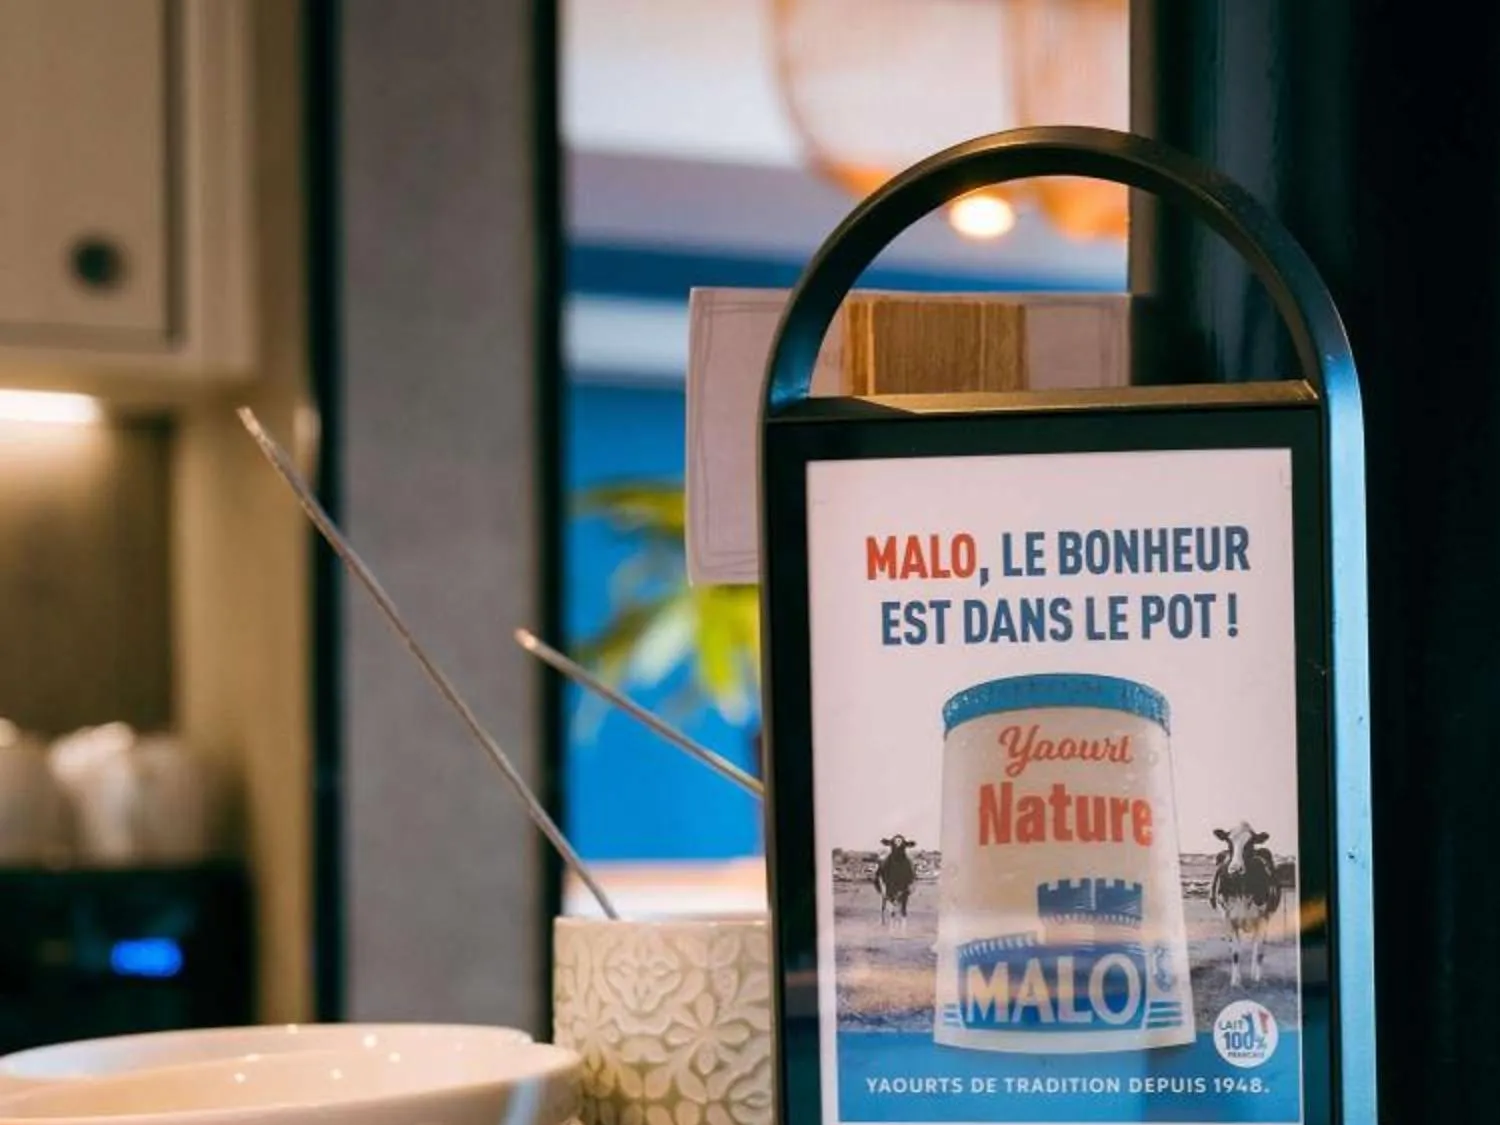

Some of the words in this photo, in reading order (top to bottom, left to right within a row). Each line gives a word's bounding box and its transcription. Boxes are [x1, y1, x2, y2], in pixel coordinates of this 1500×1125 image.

[865, 532, 990, 587] MALO,
[1002, 531, 1046, 577] LE
[1058, 525, 1251, 575] BONHEUR
[881, 599, 951, 646] EST
[963, 597, 1073, 644] DANS
[1085, 595, 1129, 641] LE
[998, 714, 1133, 778] Yaourt
[978, 781, 1154, 847] Nature
[965, 952, 1142, 1026] MALO
[1218, 1019, 1244, 1031] LAIT
[865, 1077, 964, 1095] YAOURTS
[971, 1077, 999, 1095] DE
[1004, 1076, 1121, 1095] TRADITION
[1128, 1075, 1207, 1094] DEPUIS
[1213, 1075, 1271, 1094] 1948.
